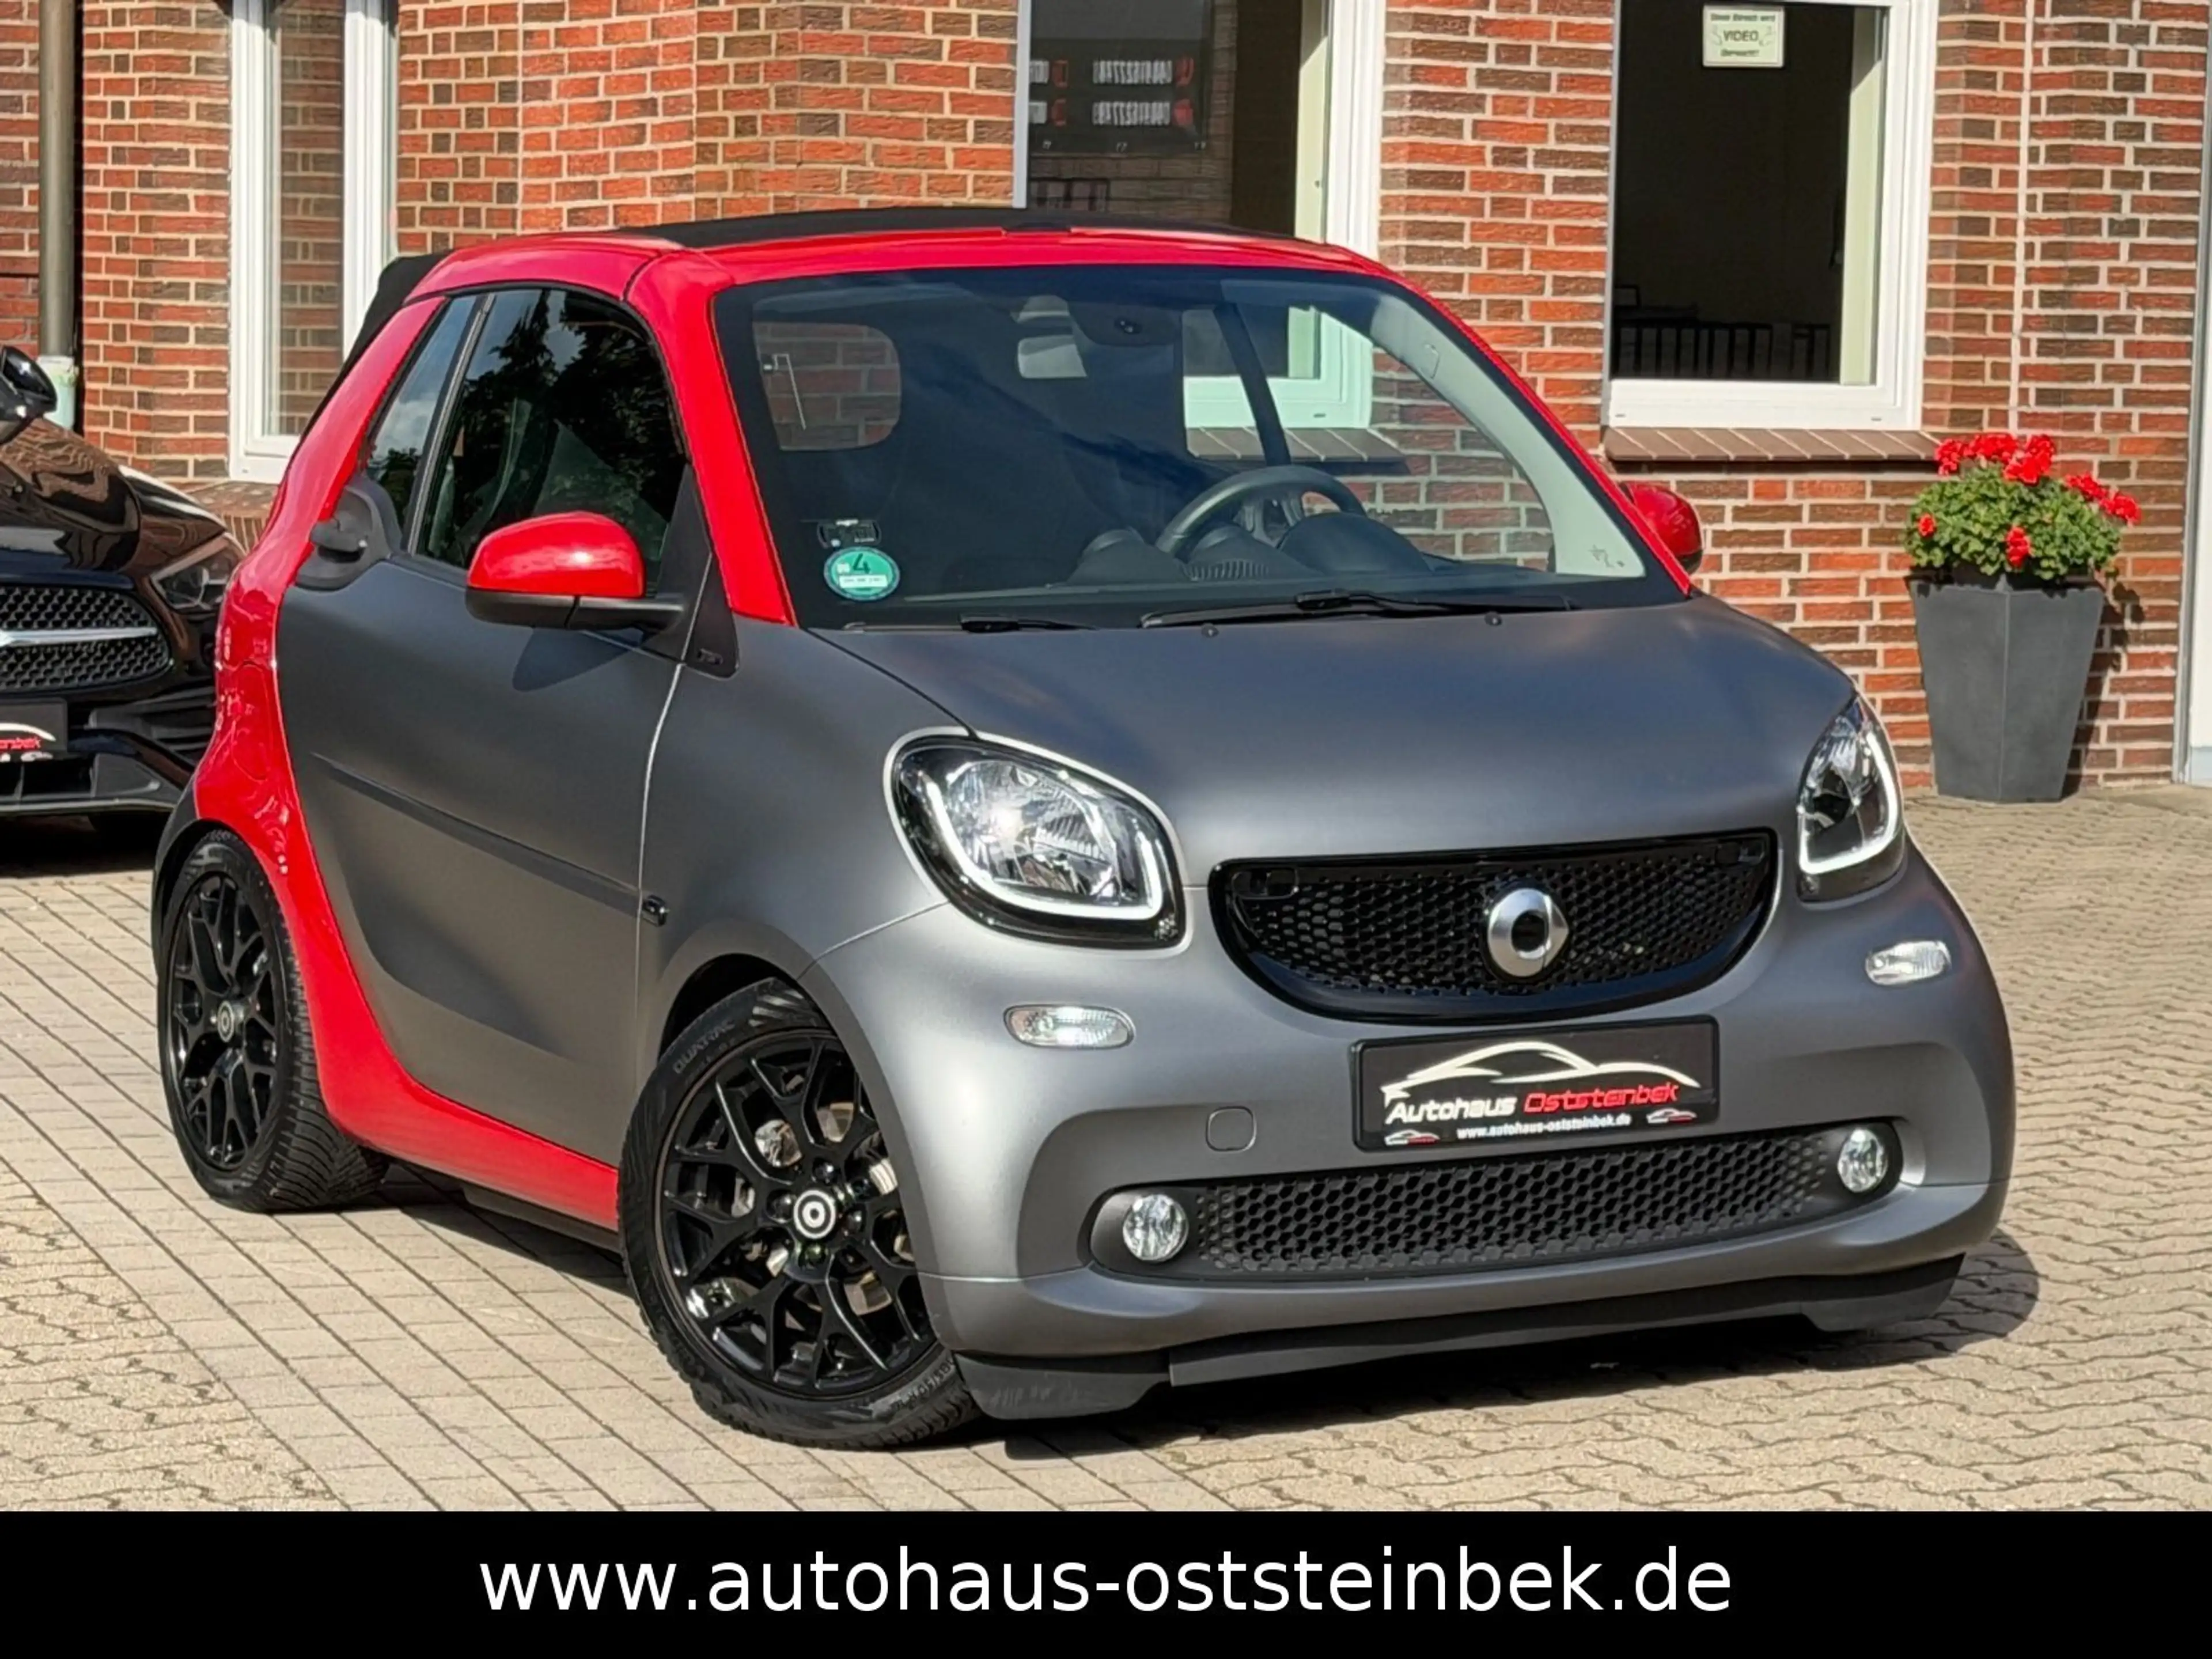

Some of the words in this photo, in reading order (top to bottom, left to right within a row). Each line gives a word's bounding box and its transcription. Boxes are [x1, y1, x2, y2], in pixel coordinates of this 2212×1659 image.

[1722, 29, 1759, 41] VIDEO
[852, 552, 871, 574] 4
[1385, 1097, 1517, 1124] Autohaus
